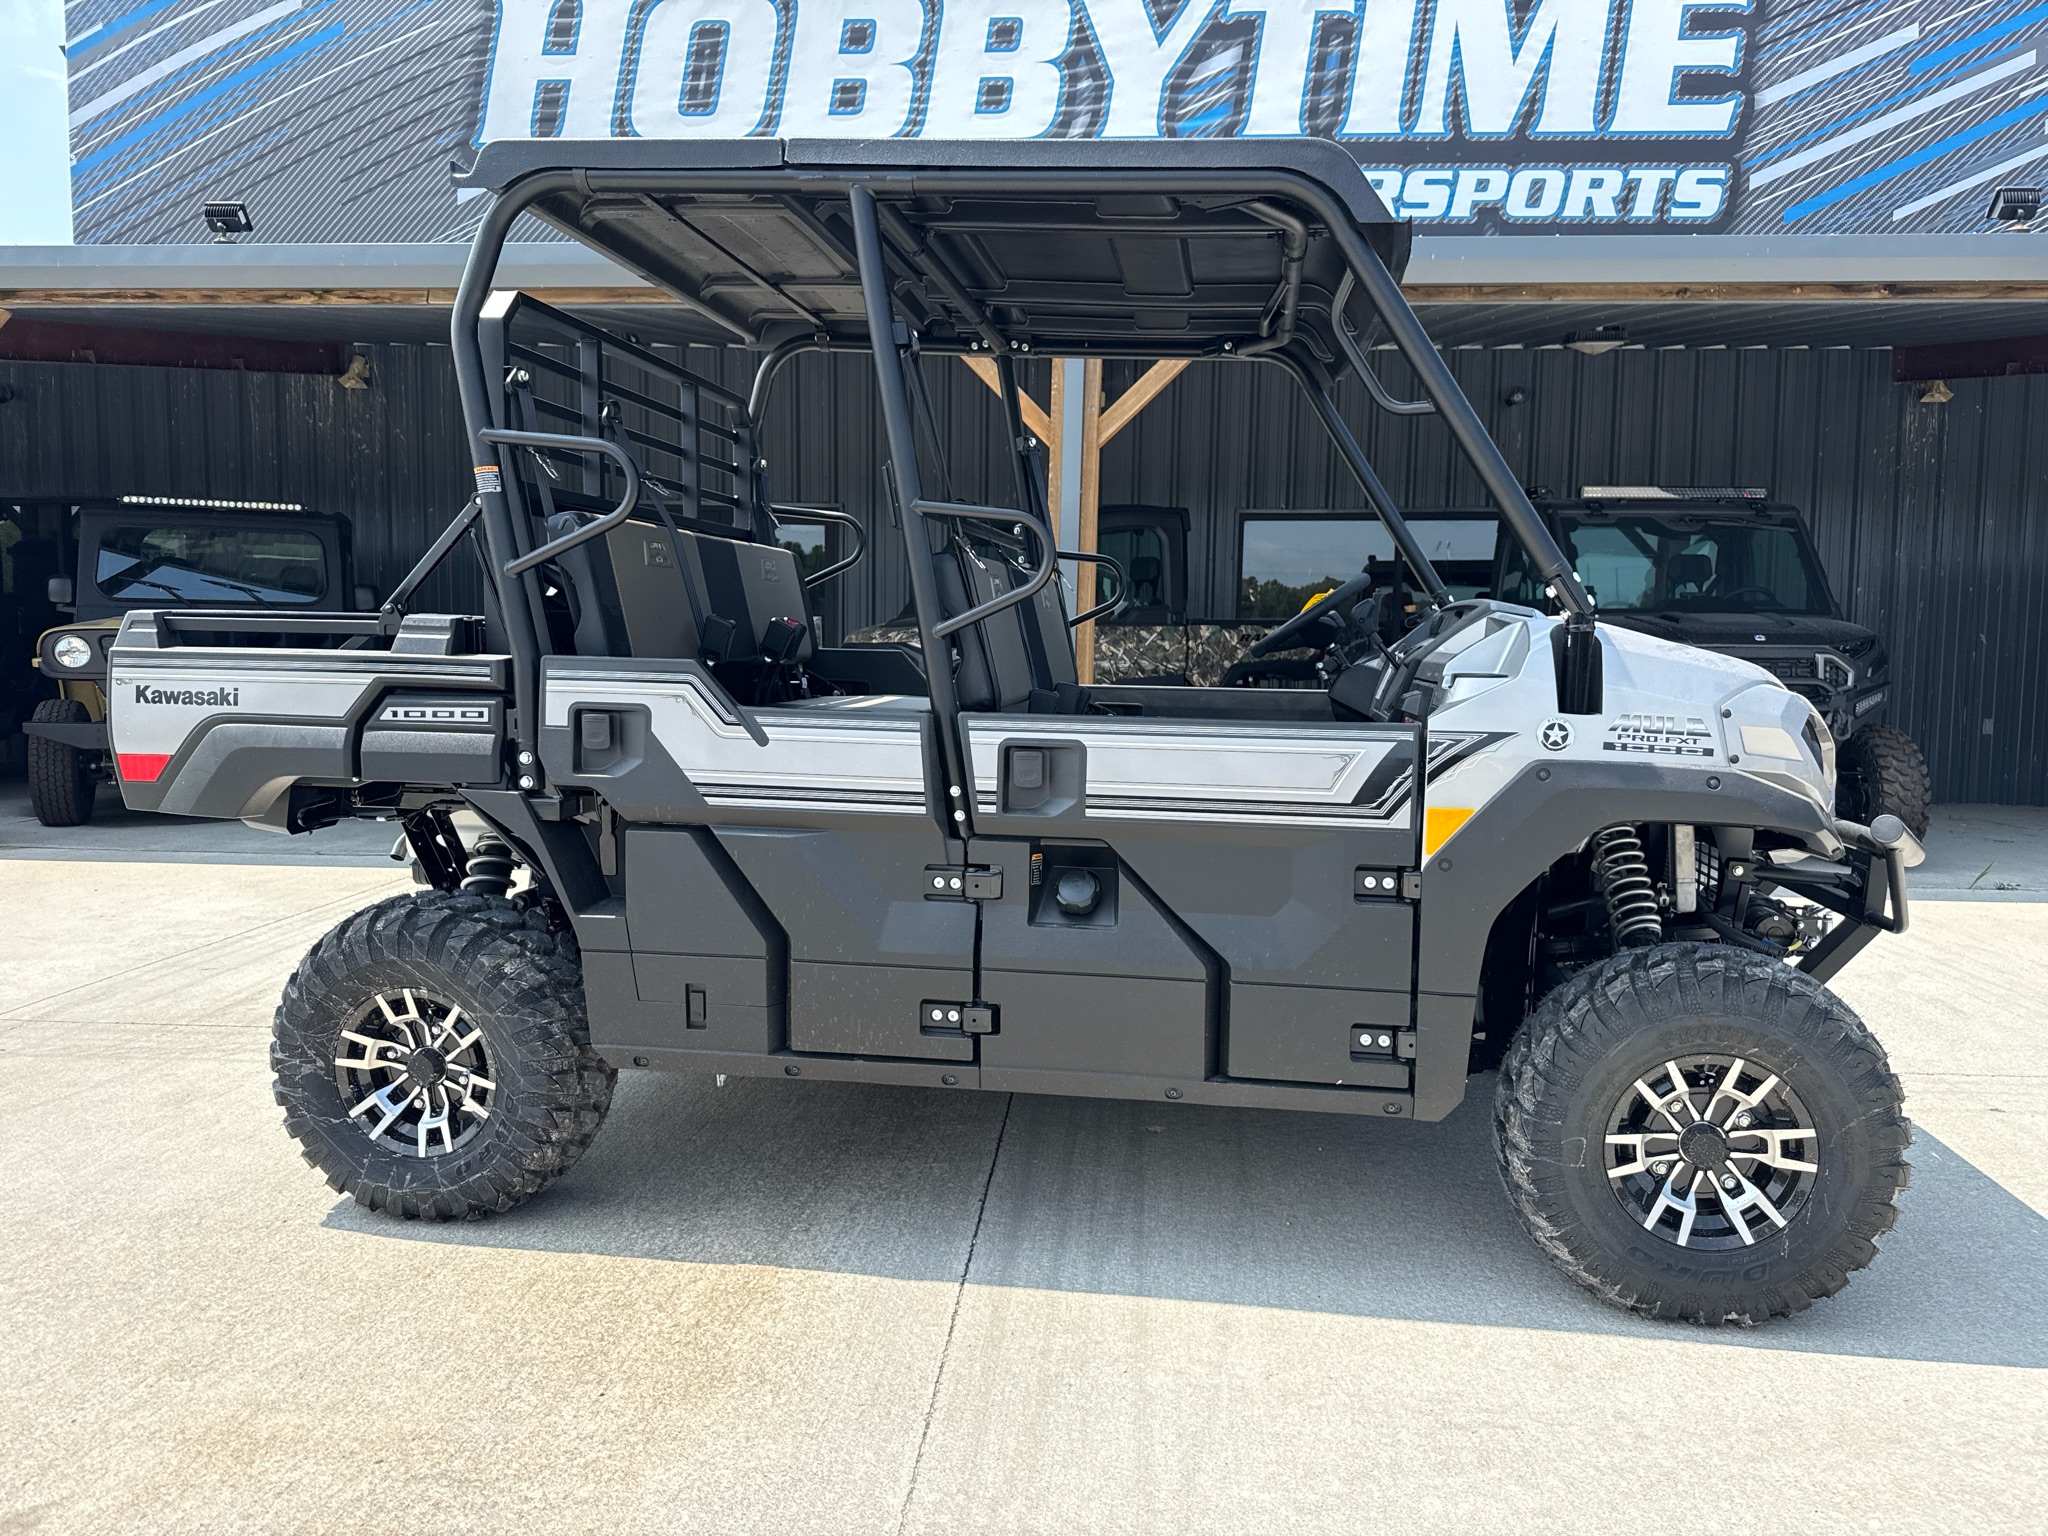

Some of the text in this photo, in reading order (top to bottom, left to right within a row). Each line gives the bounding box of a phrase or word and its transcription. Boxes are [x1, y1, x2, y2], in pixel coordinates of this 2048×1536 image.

[478, 0, 1747, 137] HOBBYTIME
[135, 684, 239, 707] Kawasaki
[389, 709, 485, 719] 1000
[1607, 713, 1713, 738] MULE
[1612, 742, 1705, 757] 1000
[1616, 733, 1703, 746] PRO-FXT
[1623, 1245, 1770, 1287] DURO
